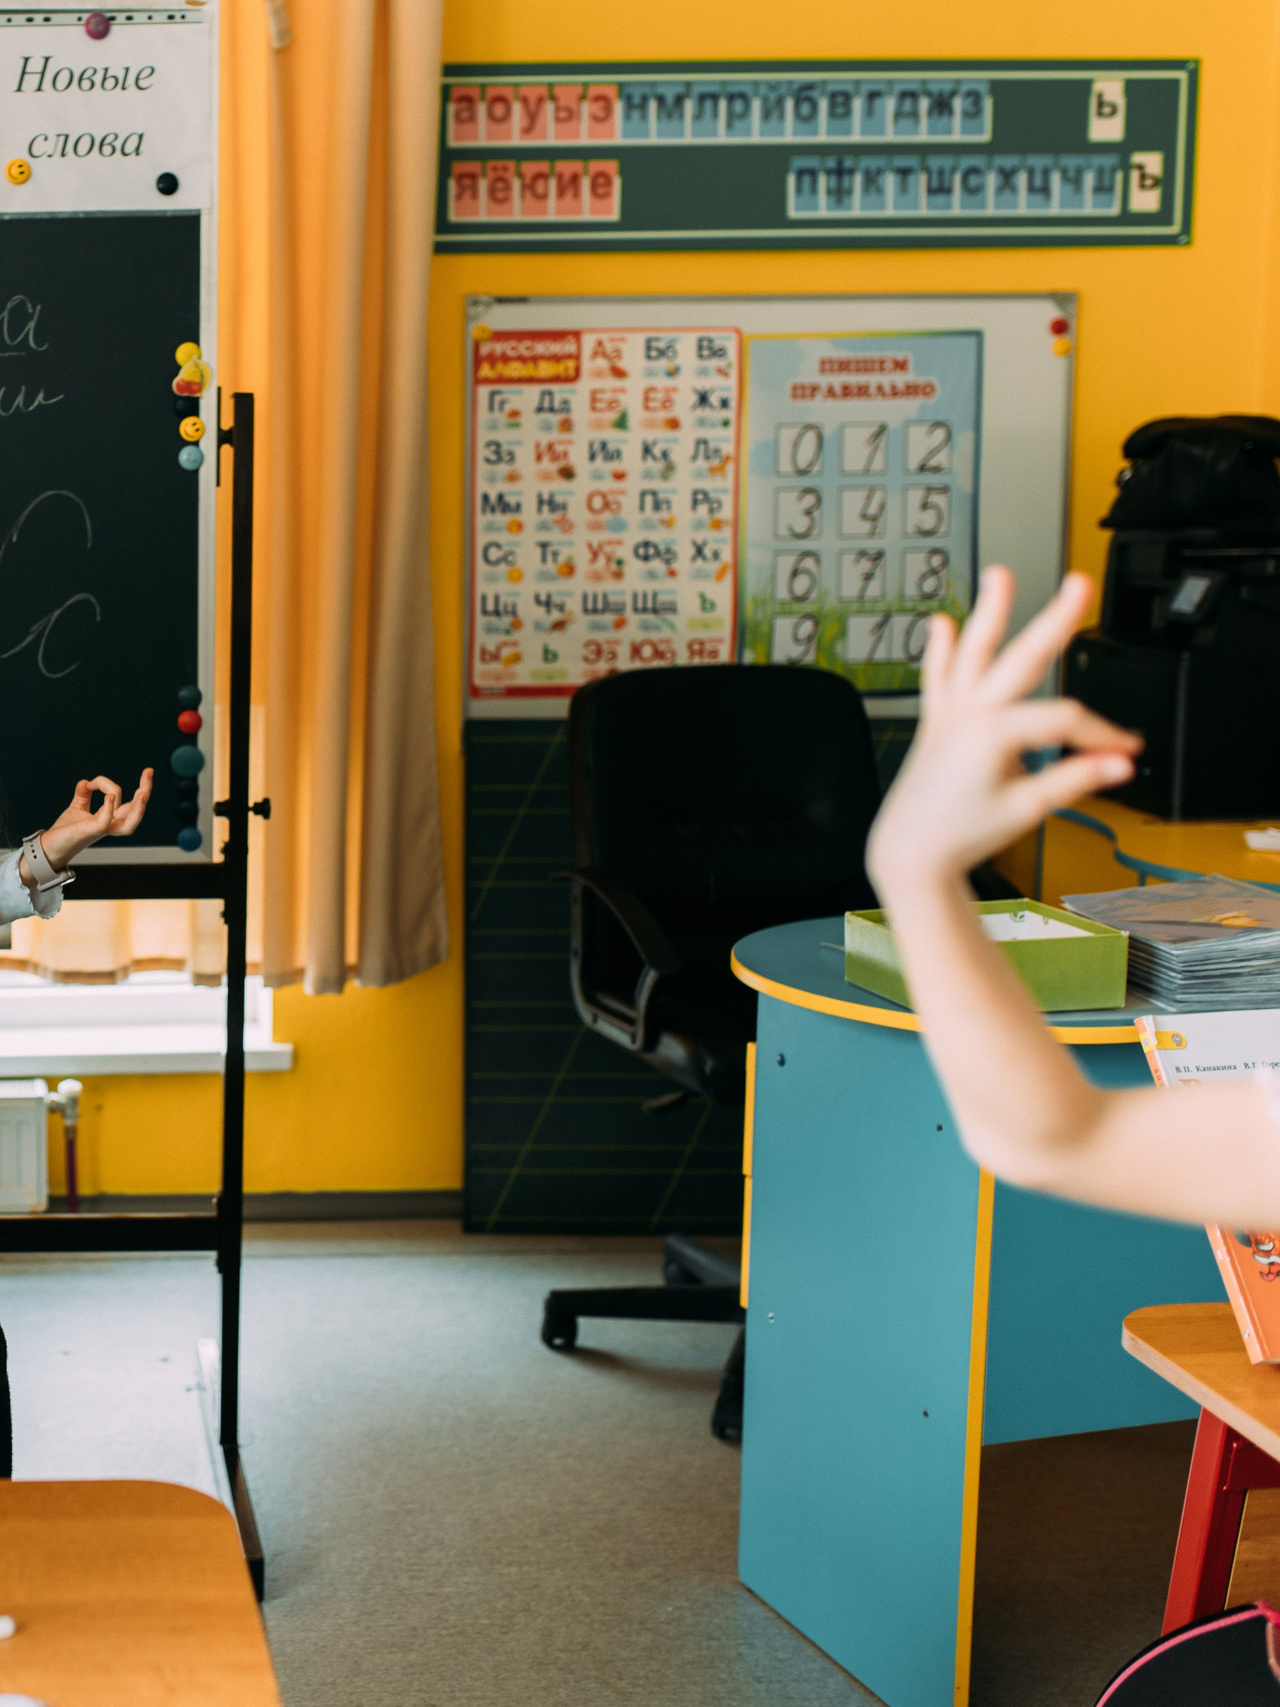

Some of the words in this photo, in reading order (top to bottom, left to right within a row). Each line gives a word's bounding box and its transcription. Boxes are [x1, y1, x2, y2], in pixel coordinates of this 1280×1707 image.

[14, 54, 157, 95] Новые
[26, 129, 145, 159] слова
[789, 381, 937, 402] ПРАВИЛЬНО
[790, 423, 823, 477] 0
[865, 421, 888, 475] 1
[918, 421, 952, 474] 2
[787, 487, 822, 539] 3
[859, 486, 887, 537] 4
[915, 484, 951, 537] 5
[788, 550, 820, 603] 6
[853, 549, 886, 600] 7
[917, 547, 950, 600] 8
[786, 612, 819, 665] 9
[1195, 1063, 1238, 1073] Канакина
